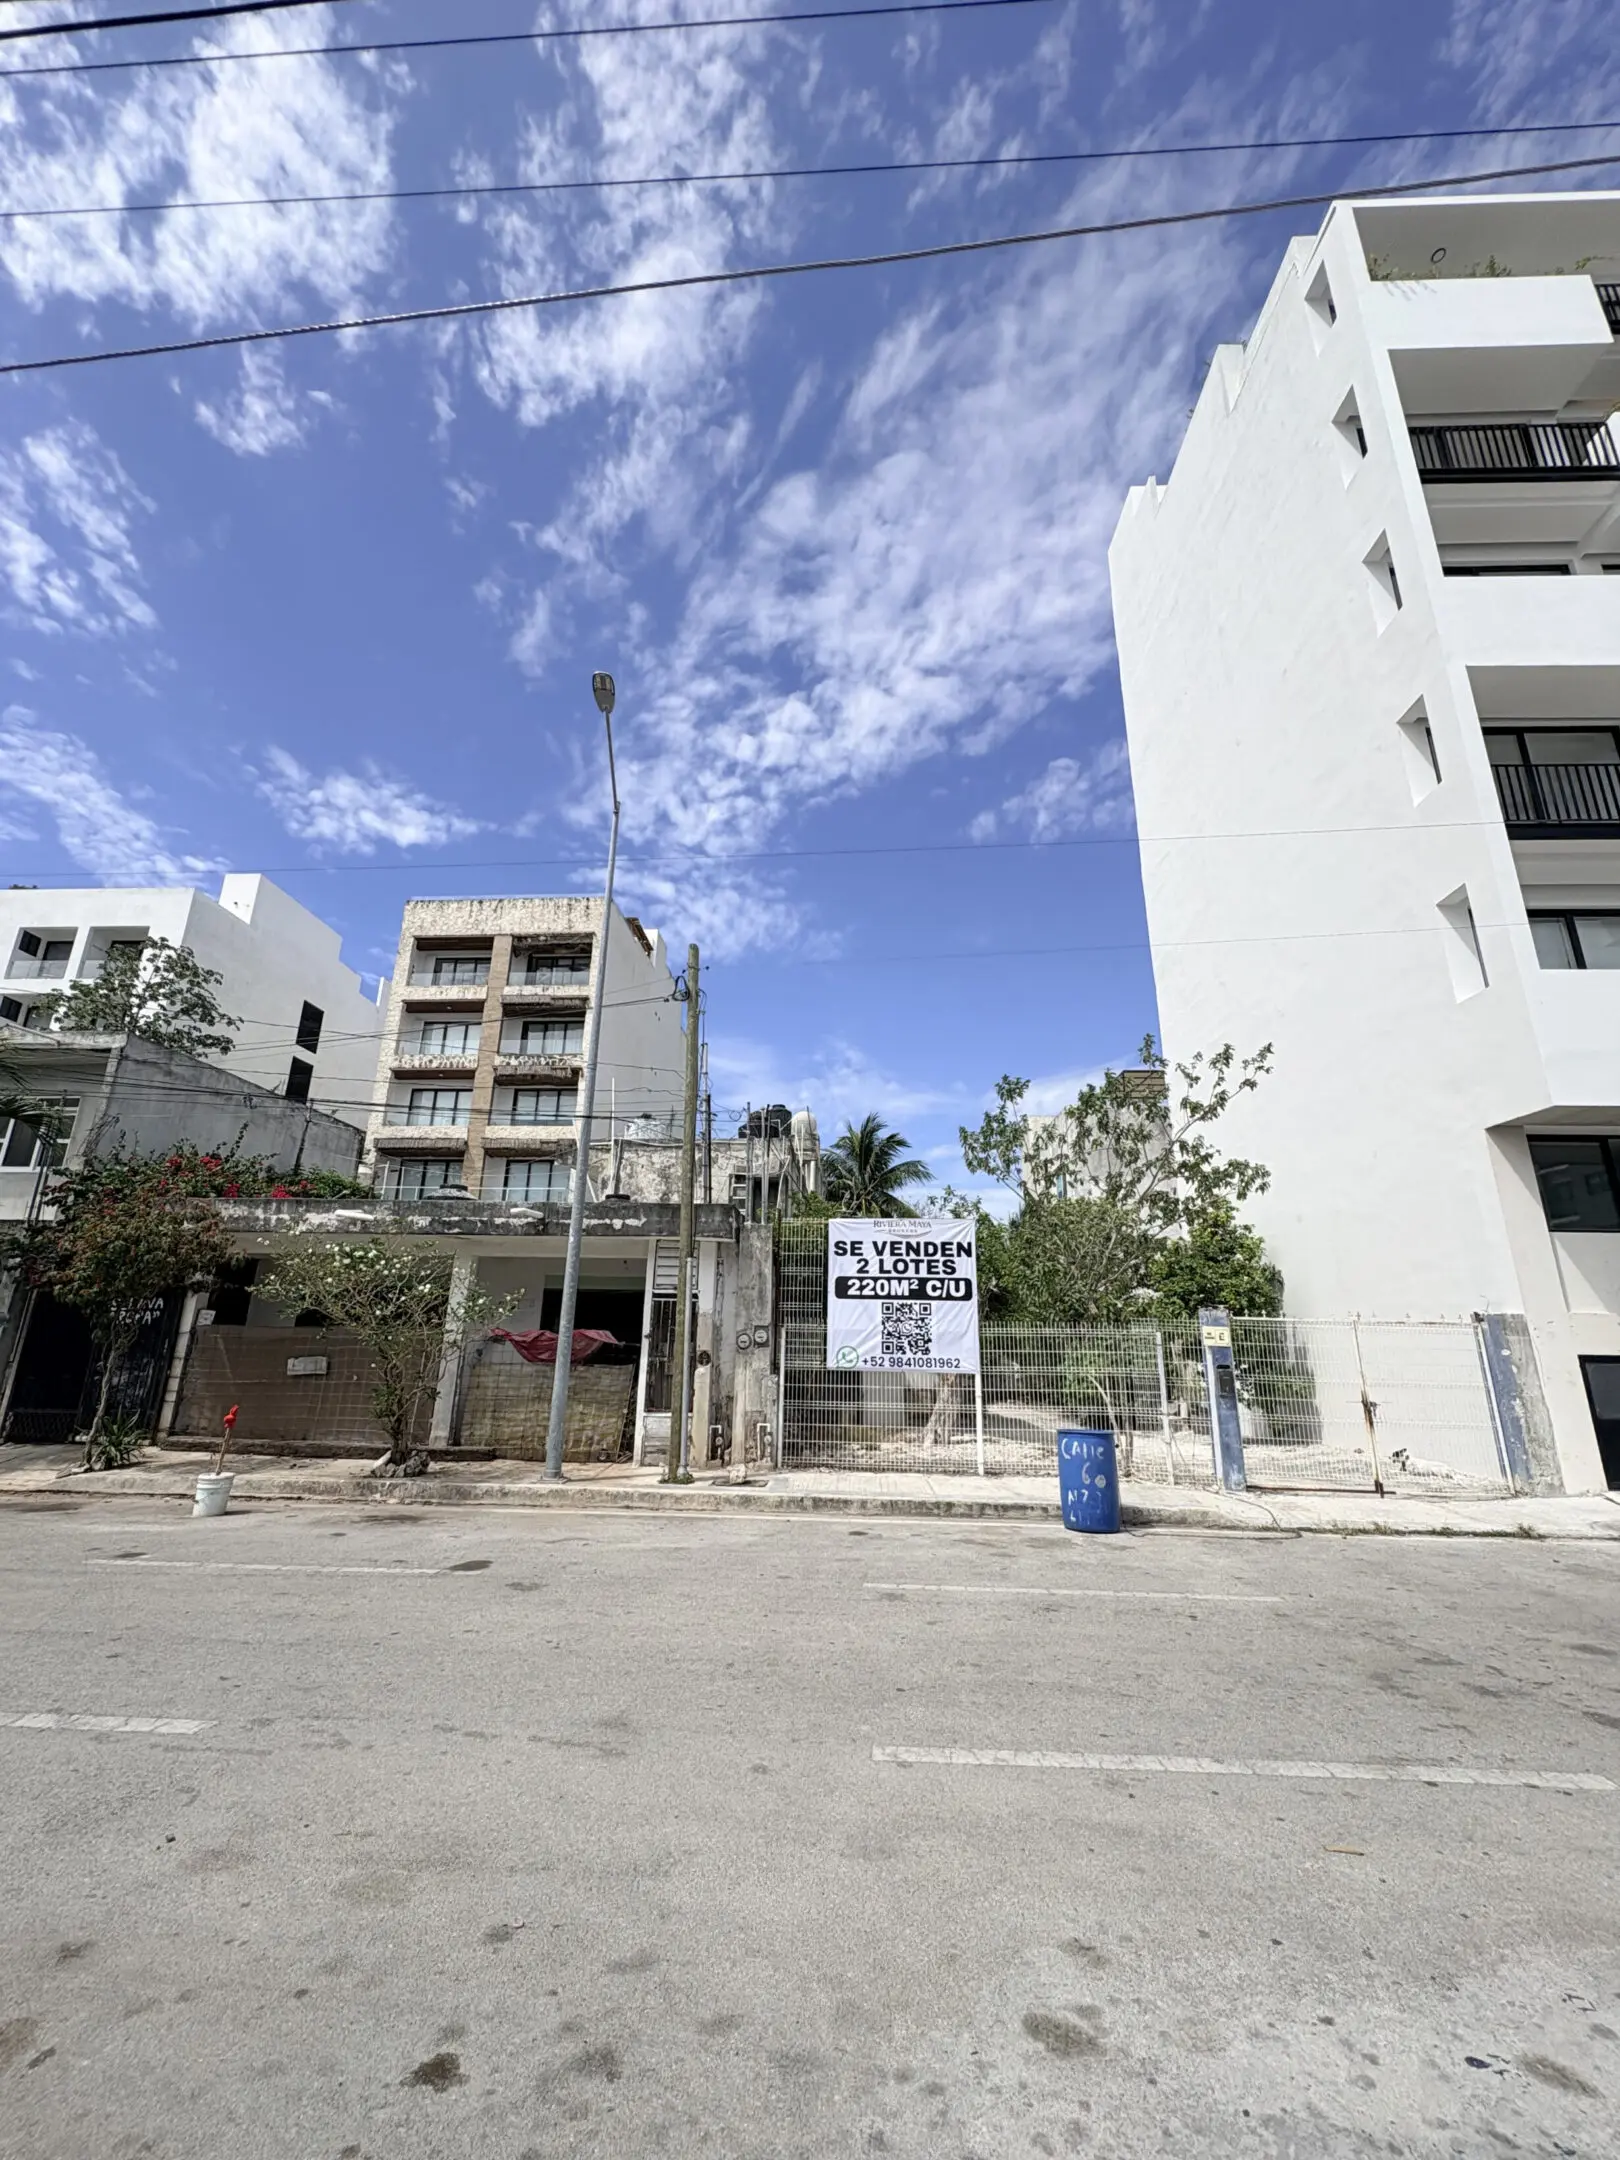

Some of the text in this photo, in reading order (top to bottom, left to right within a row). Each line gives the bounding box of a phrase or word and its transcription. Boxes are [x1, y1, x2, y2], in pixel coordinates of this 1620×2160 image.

[873, 1220, 932, 1228] RIVIERA MAYA
[834, 1241, 972, 1258] SE VENDEN
[856, 1259, 957, 1275] 2 LOTES
[926, 1280, 966, 1298] C/U
[862, 1357, 960, 1369] +52 9841081962
